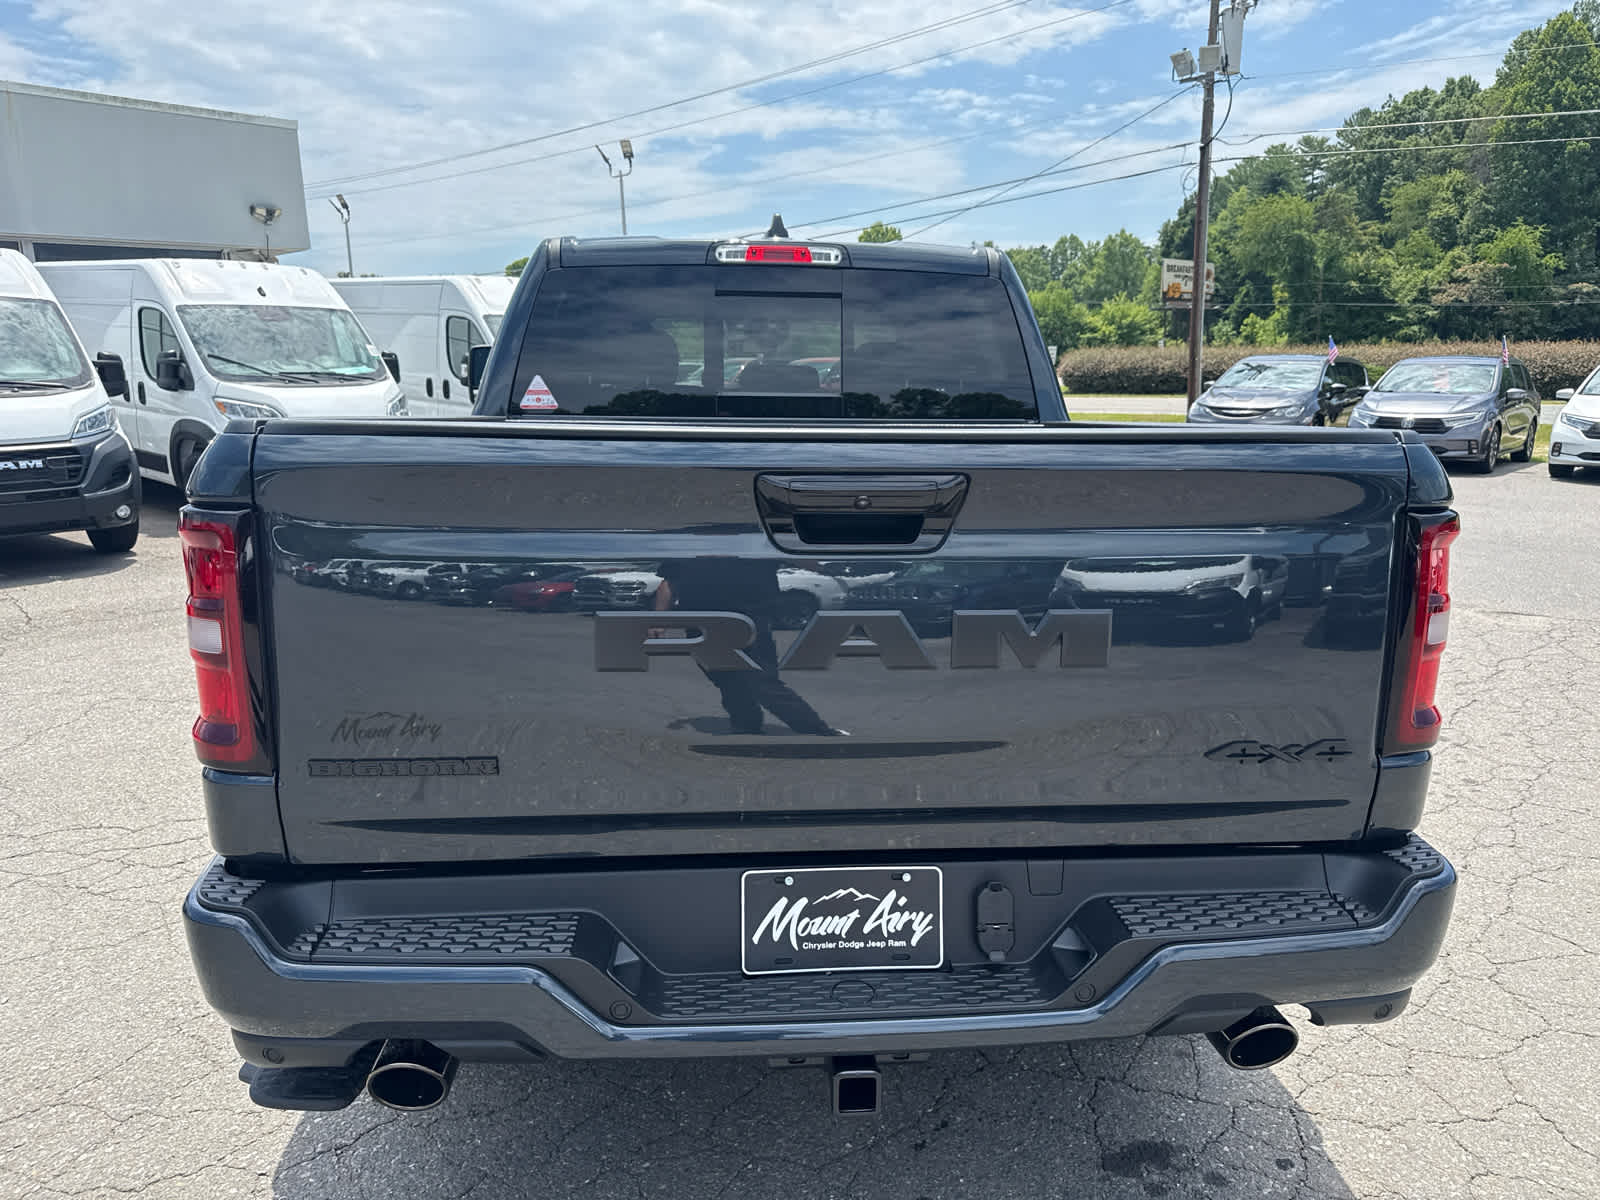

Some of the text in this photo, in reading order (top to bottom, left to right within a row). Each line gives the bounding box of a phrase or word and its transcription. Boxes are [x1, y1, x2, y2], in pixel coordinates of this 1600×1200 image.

[0, 460, 43, 470] AM
[595, 609, 1113, 672] RAM
[331, 712, 442, 744] Mount Airy
[752, 889, 934, 951] Mount Airy
[802, 939, 907, 950] Chrysler Dodge Jeep Ram
